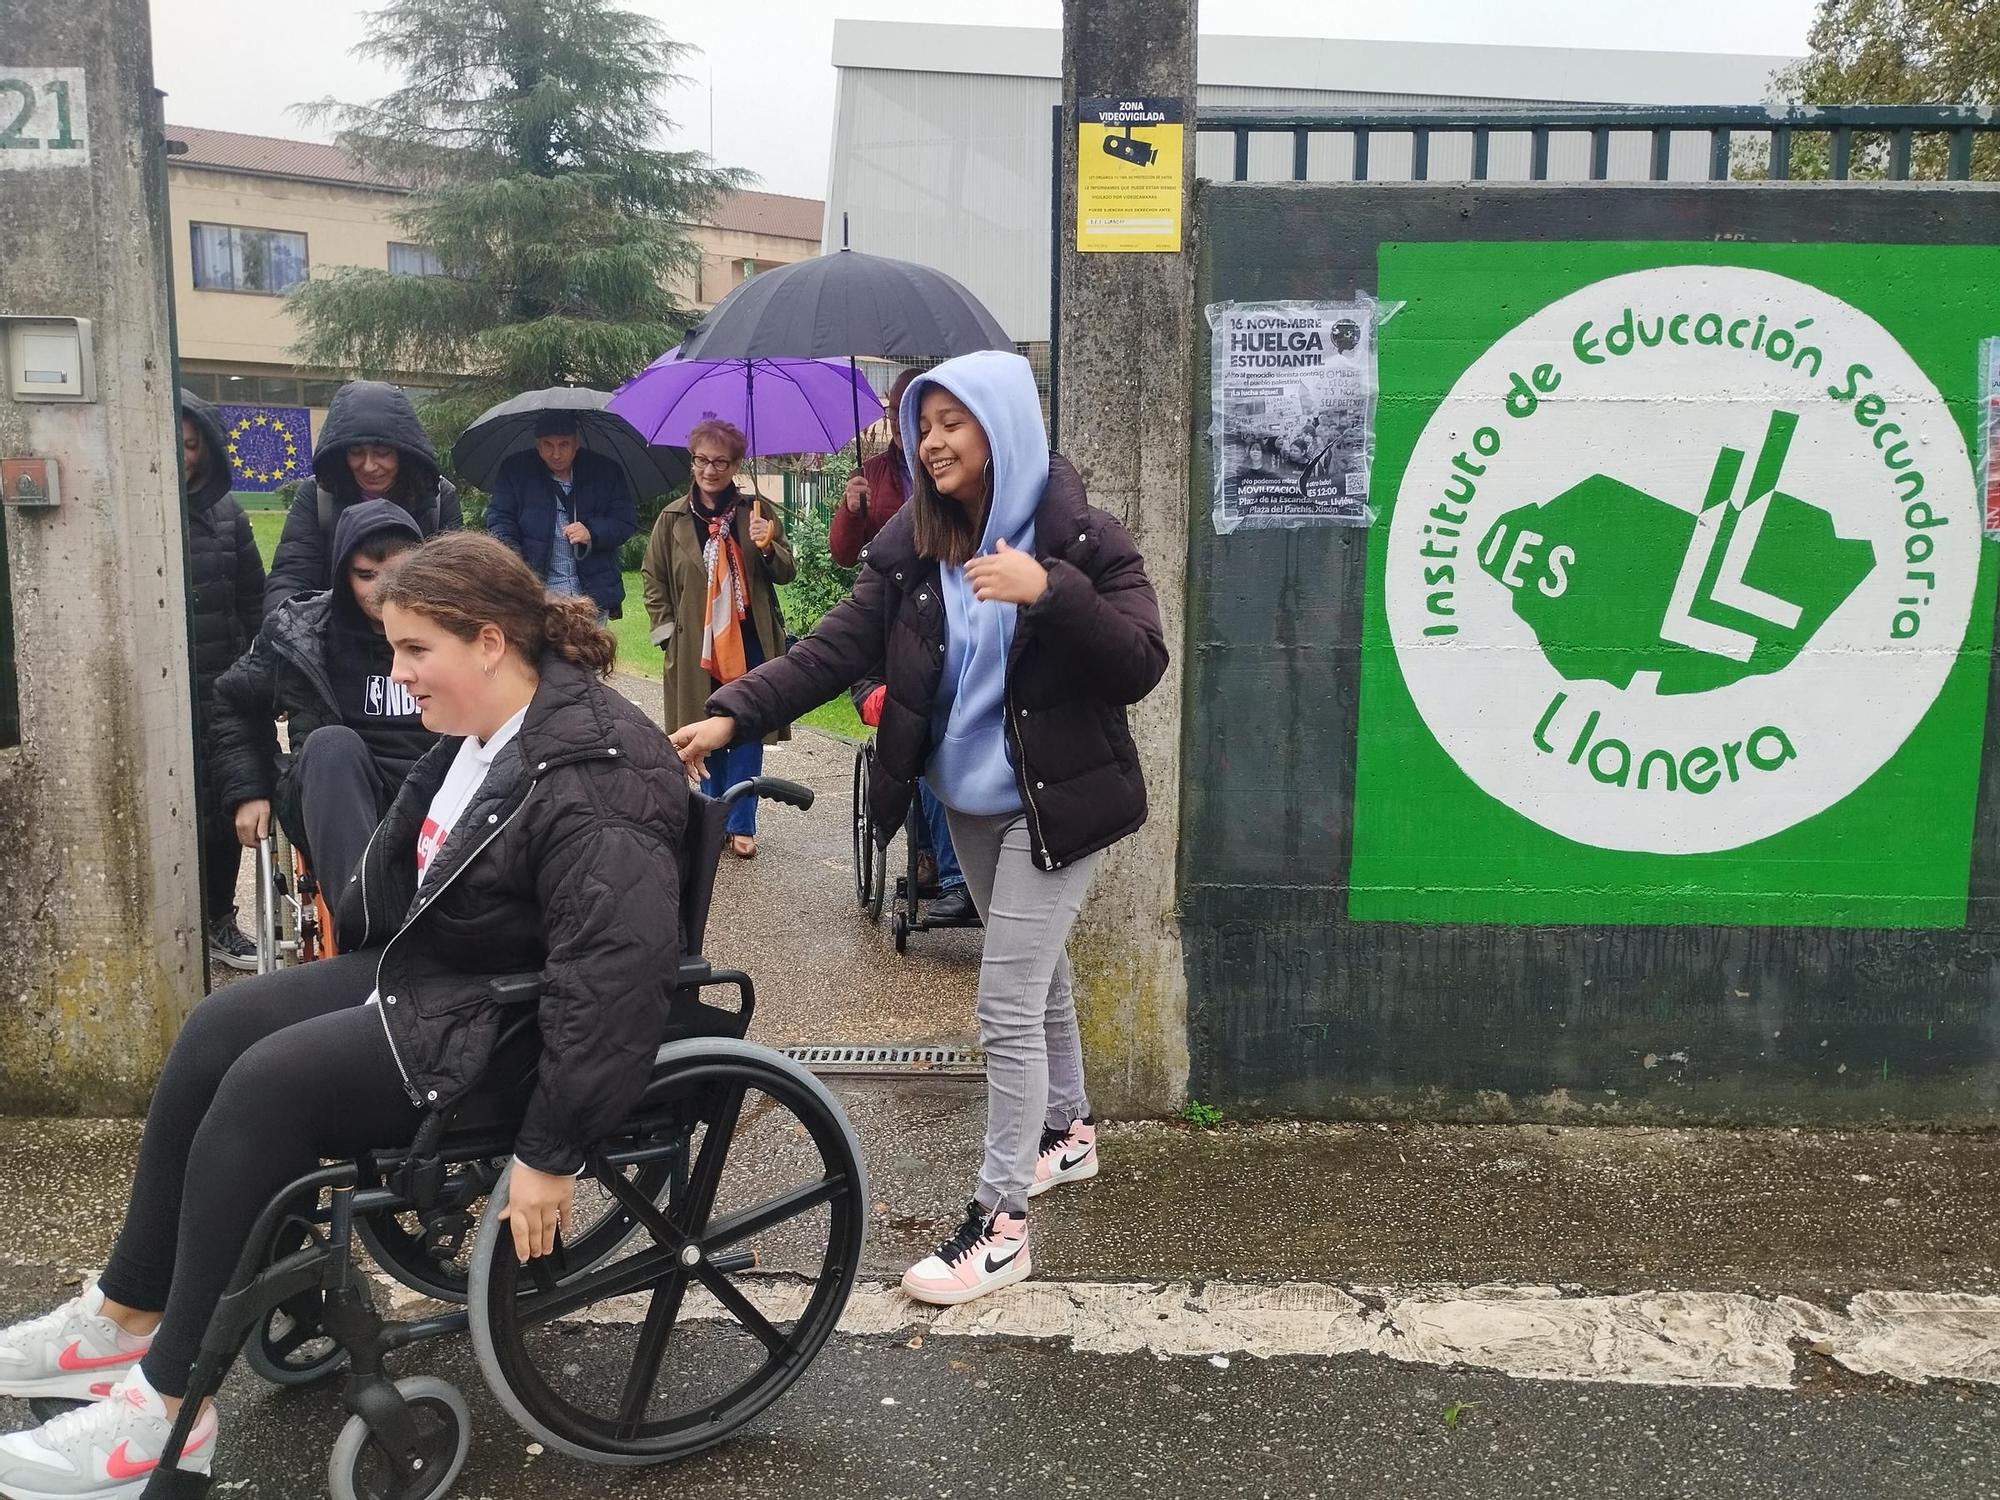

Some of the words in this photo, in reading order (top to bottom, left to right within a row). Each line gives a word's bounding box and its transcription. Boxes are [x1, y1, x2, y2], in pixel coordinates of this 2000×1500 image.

[1119, 101, 1144, 111] ZONA
[0, 78, 84, 150] 21
[1099, 111, 1165, 121] VIDEOVIGILADA
[1231, 318, 1243, 330] 16
[1246, 317, 1322, 330] NOVIEMBRE
[1230, 331, 1324, 352] HUELGA
[1230, 353, 1326, 368] ESTUDIANTIL
[1246, 371, 1275, 379] genocidio
[1240, 389, 1259, 397] lucha
[1420, 425, 1502, 638] Instituto
[1505, 361, 1563, 419] de
[1572, 308, 1823, 377] Educación
[1827, 363, 1949, 641] Secundaria
[1253, 478, 1281, 486] podemos
[1317, 486, 1338, 497] 12:00
[1259, 495, 1270, 503] de
[1270, 495, 1278, 503] la
[1249, 505, 1270, 514] Plaza
[1270, 505, 1283, 513] del
[1315, 504, 1338, 514] Xixón
[1482, 524, 1576, 598] IES
[386, 676, 422, 716] NB
[1532, 691, 1798, 795] Llanera
